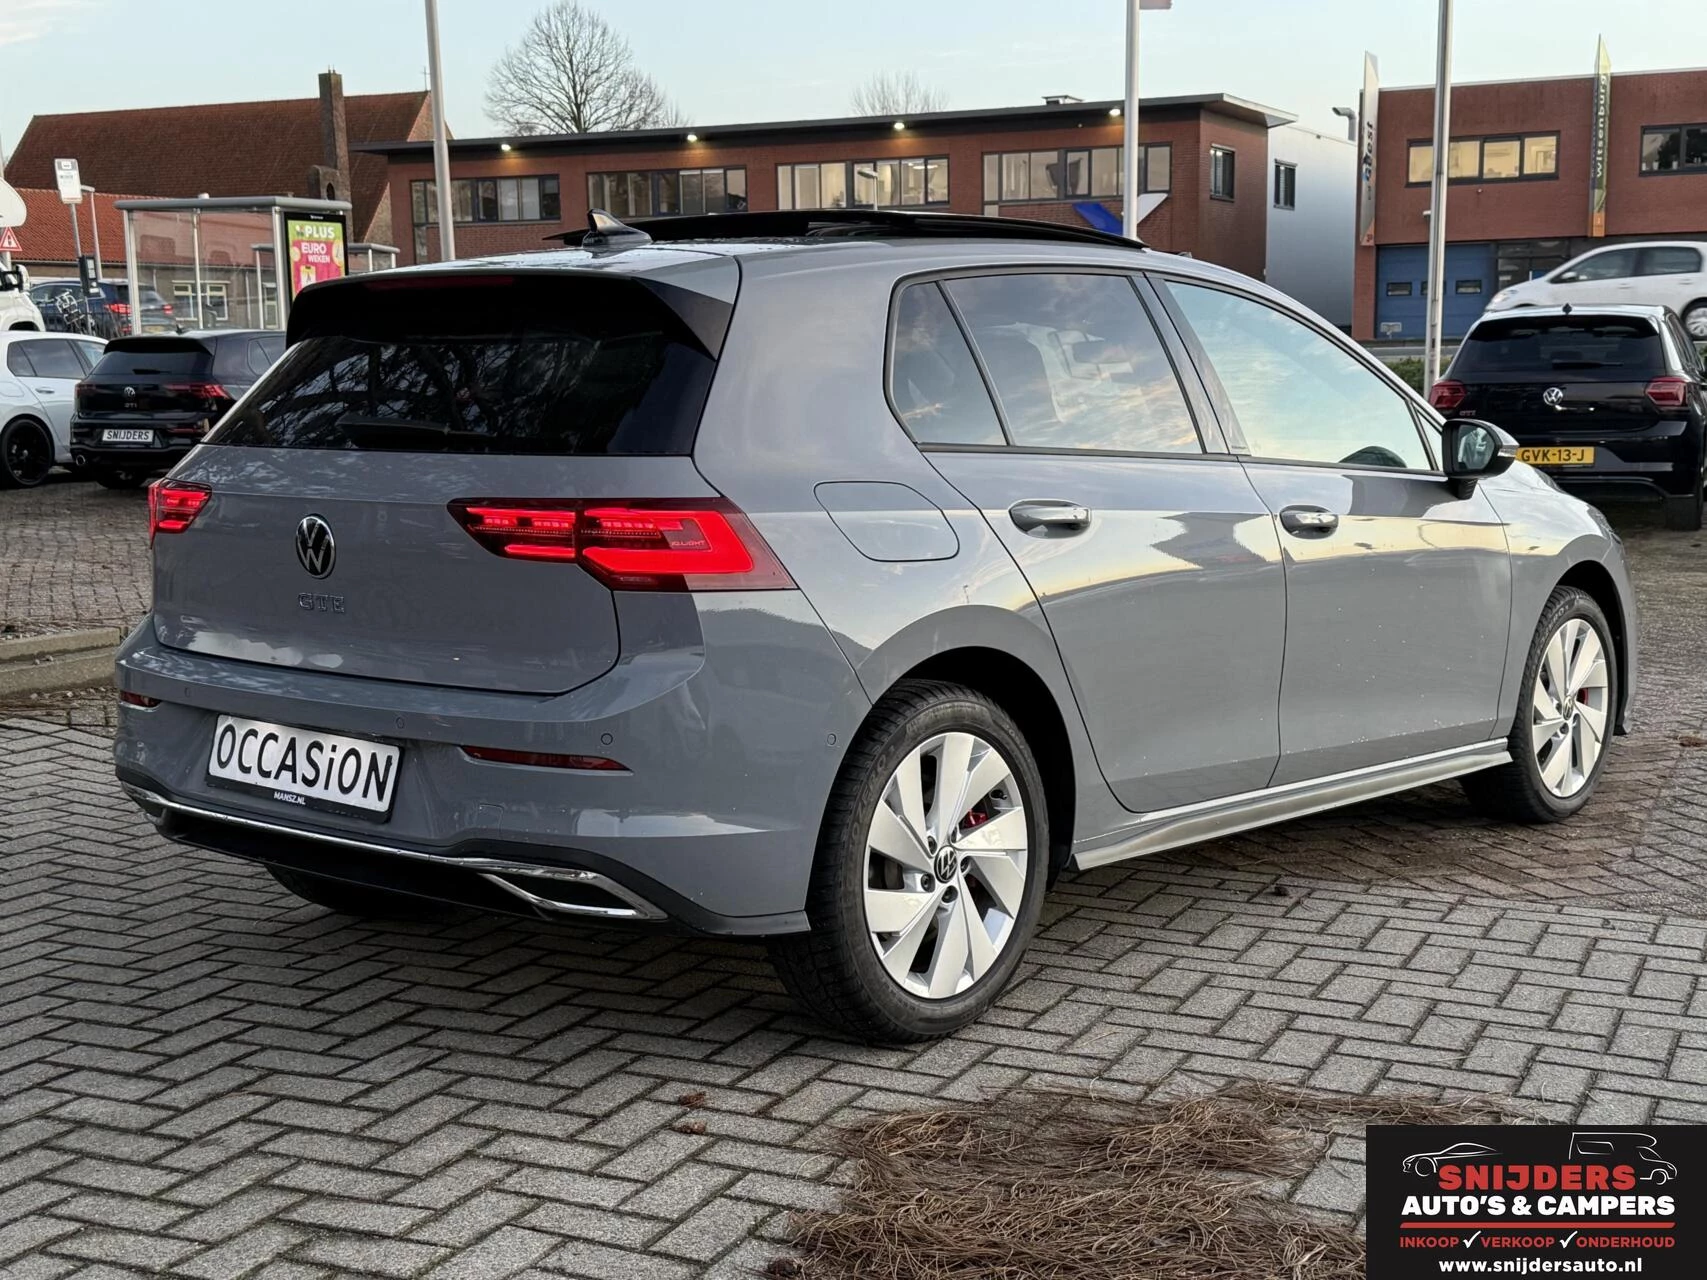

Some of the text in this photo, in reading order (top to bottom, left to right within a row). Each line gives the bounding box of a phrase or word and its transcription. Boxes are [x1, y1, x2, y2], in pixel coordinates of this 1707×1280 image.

[1596, 75, 1607, 178] witsenburg
[305, 225, 335, 238] PLUS
[301, 242, 327, 254] EURO
[308, 255, 331, 264] WEKEN
[106, 430, 149, 440] SNIJDERS
[1521, 449, 1585, 462] GVK-13-J
[298, 592, 344, 613] GTE
[273, 791, 306, 805] MANSZ.NL
